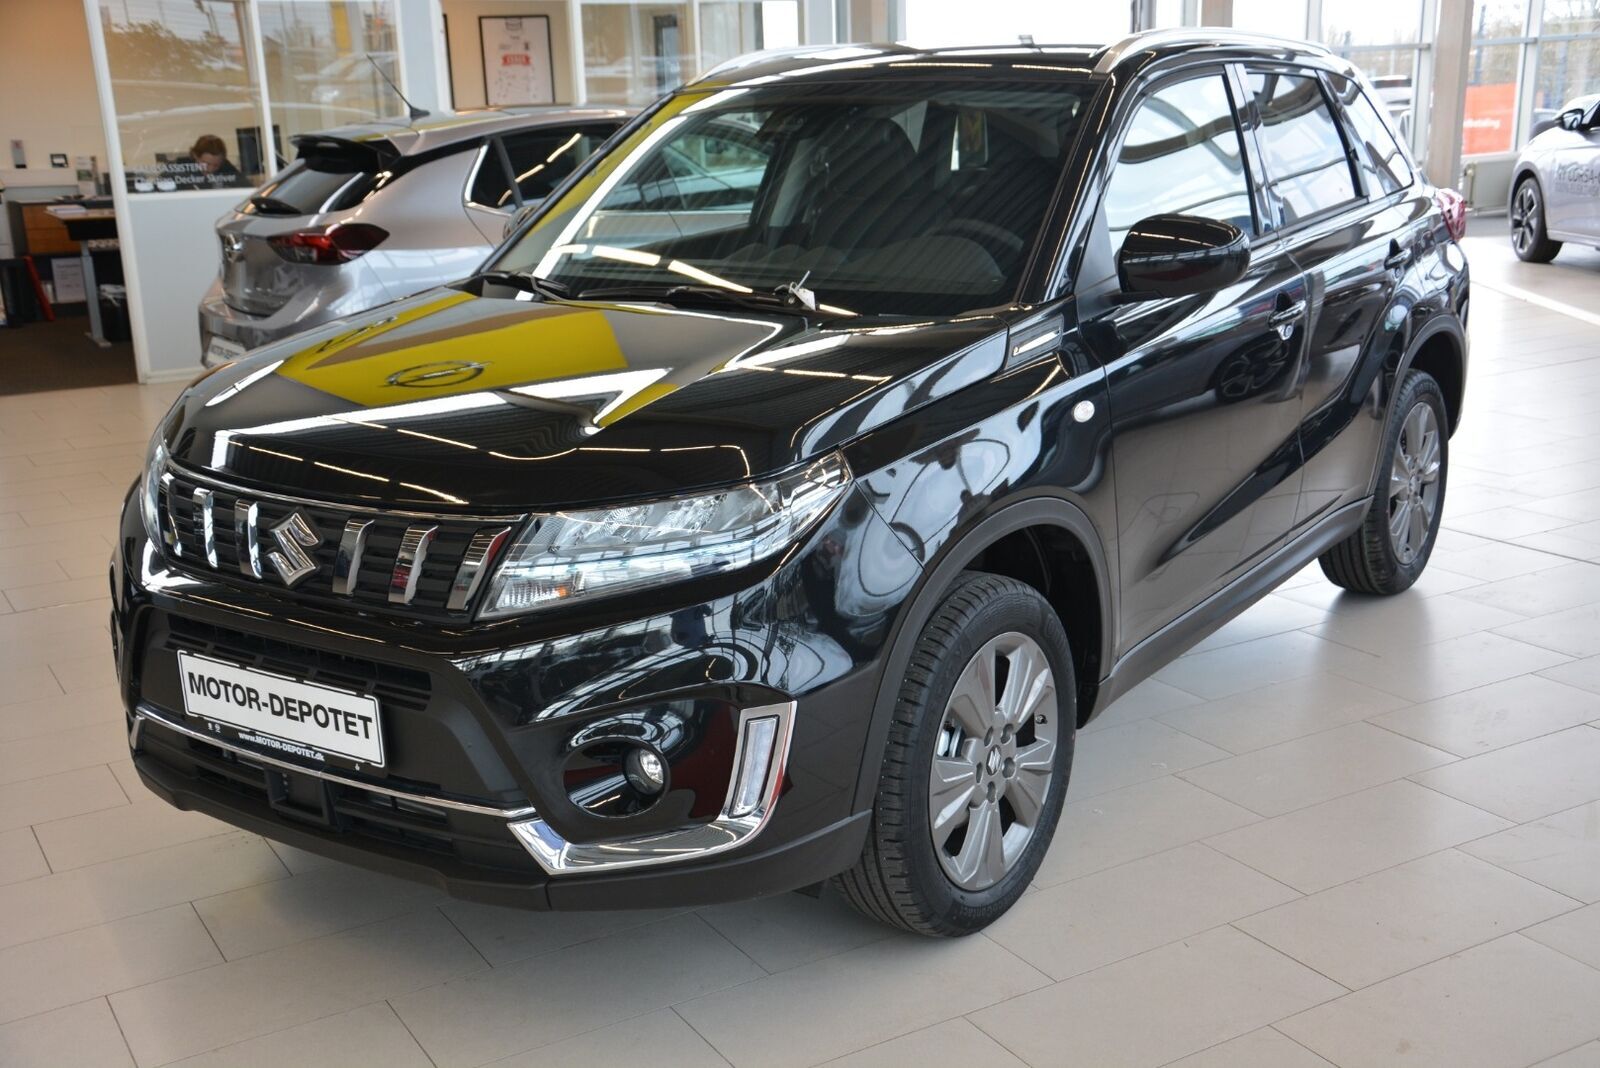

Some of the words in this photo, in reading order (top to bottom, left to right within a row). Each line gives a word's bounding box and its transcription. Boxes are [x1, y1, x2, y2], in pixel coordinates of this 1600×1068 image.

[174, 175, 205, 184] Decker
[206, 174, 236, 183] Skriver
[187, 671, 373, 740] MOTOR-DEPOTET
[237, 732, 326, 761] www.MOTOR-DEPOTET.dk
